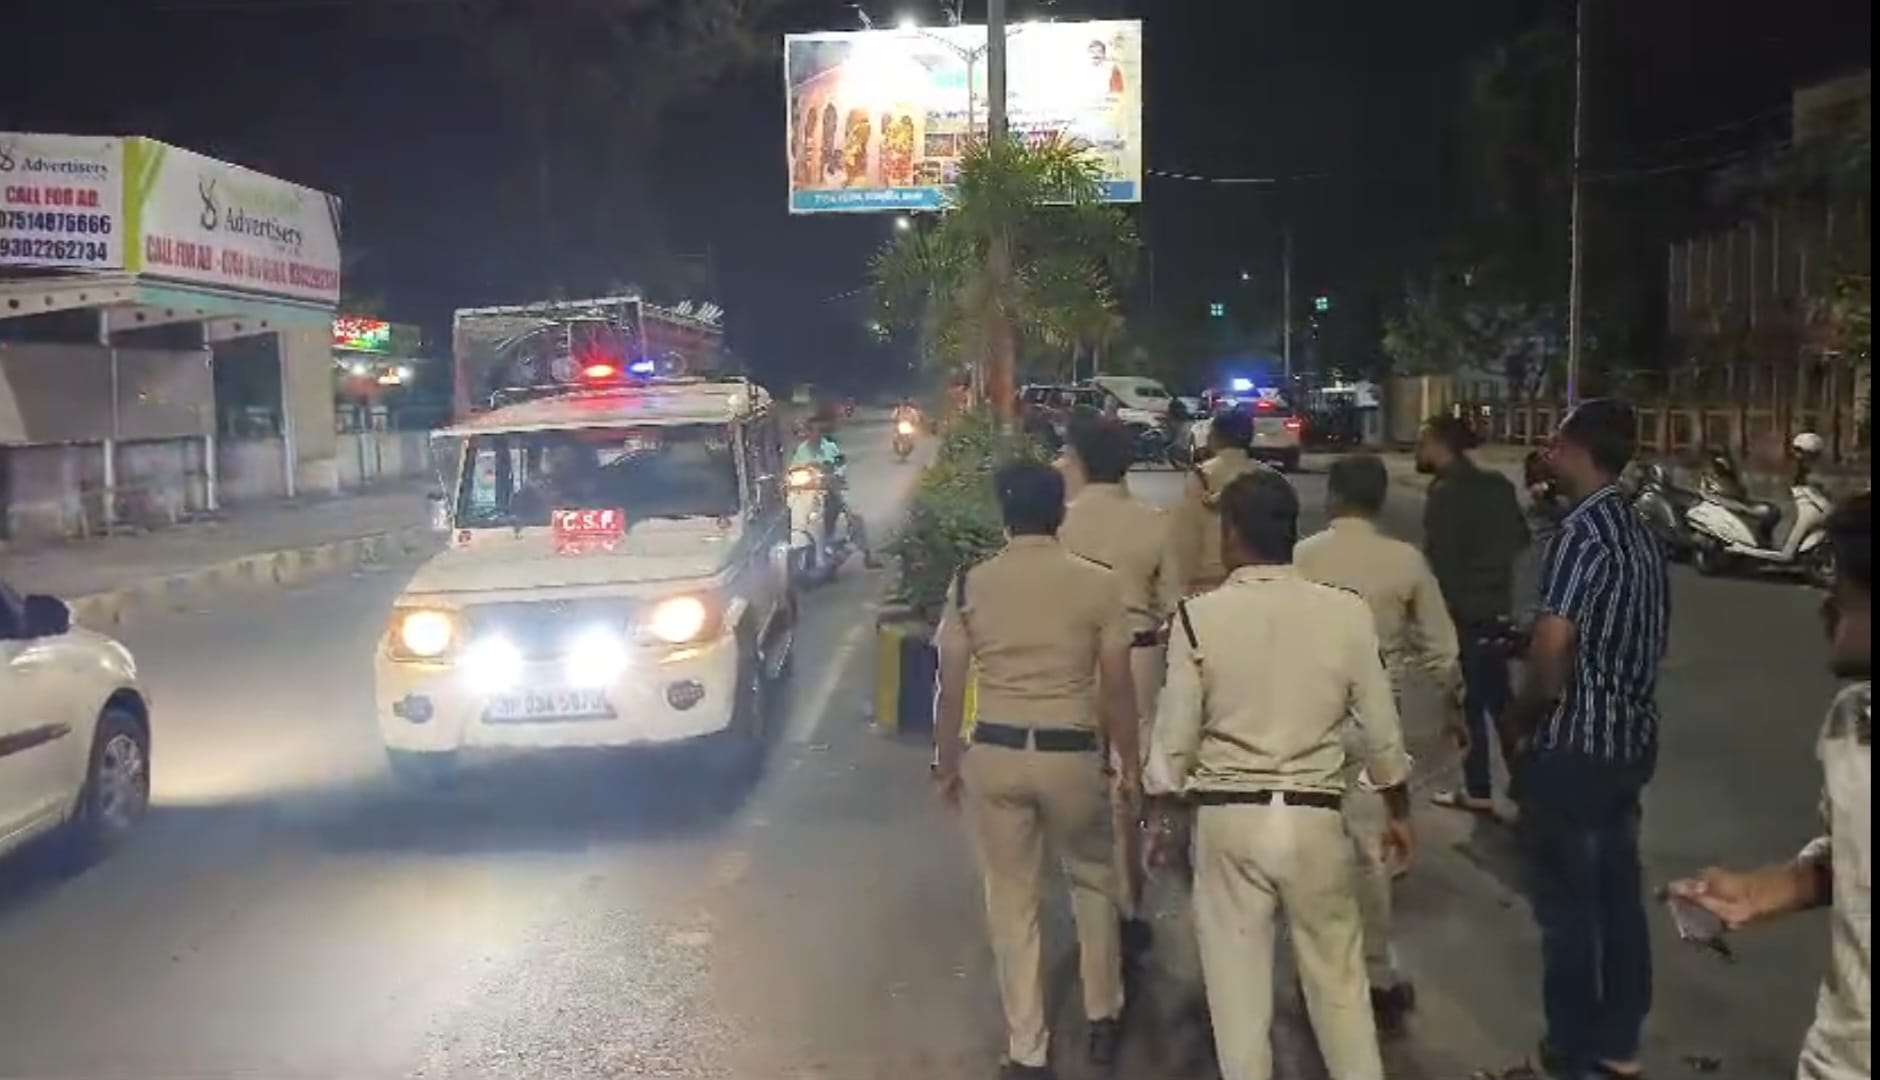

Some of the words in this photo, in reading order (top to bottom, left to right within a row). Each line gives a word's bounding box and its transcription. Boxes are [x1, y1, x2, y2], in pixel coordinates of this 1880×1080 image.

[21, 158, 108, 173] Advertisers
[6, 185, 41, 206] CALL
[45, 187, 74, 206] FOR
[225, 207, 303, 246] Advertisers
[0, 238, 108, 261] 9302262734
[146, 234, 173, 265] CALL
[175, 240, 196, 270] FOR
